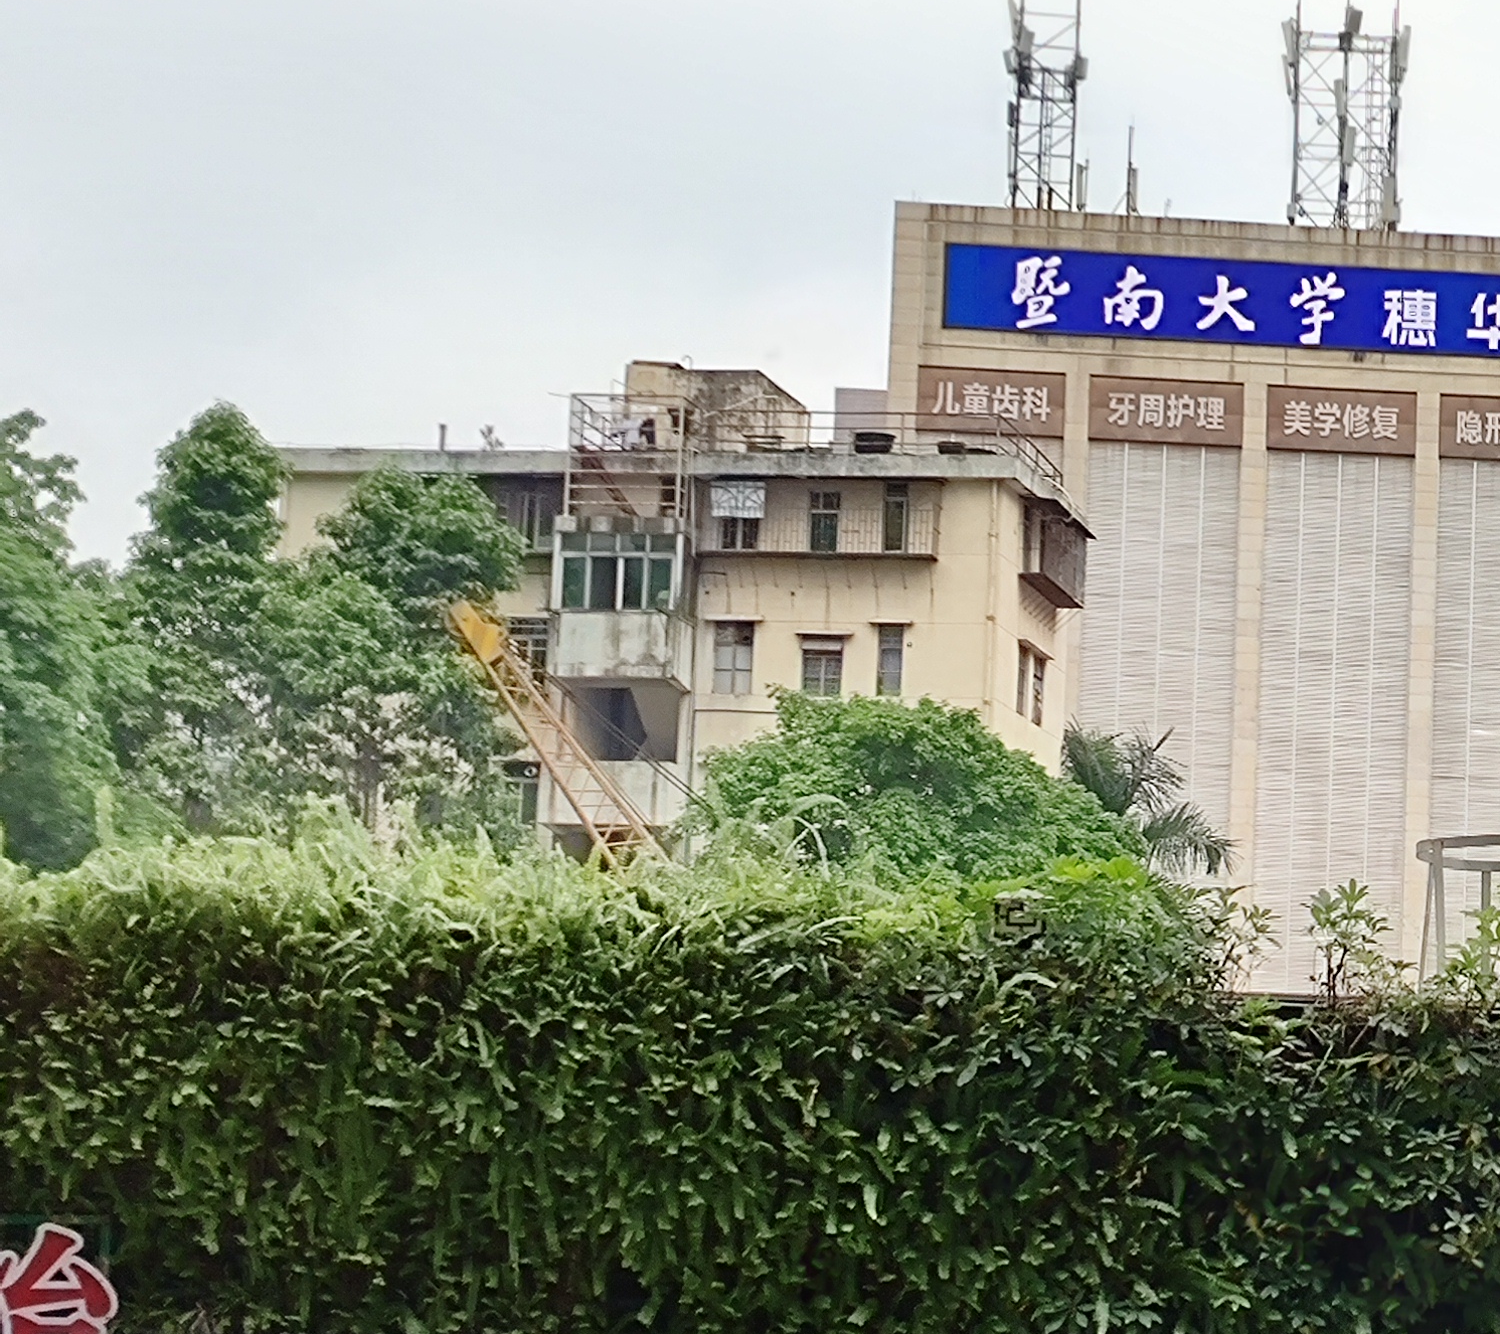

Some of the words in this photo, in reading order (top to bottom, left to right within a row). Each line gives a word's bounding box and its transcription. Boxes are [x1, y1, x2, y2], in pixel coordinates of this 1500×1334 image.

[931, 380, 1051, 423] 儿童齿科
[1106, 391, 1227, 432] 牙周护理
[1283, 400, 1400, 441] 美学修复
